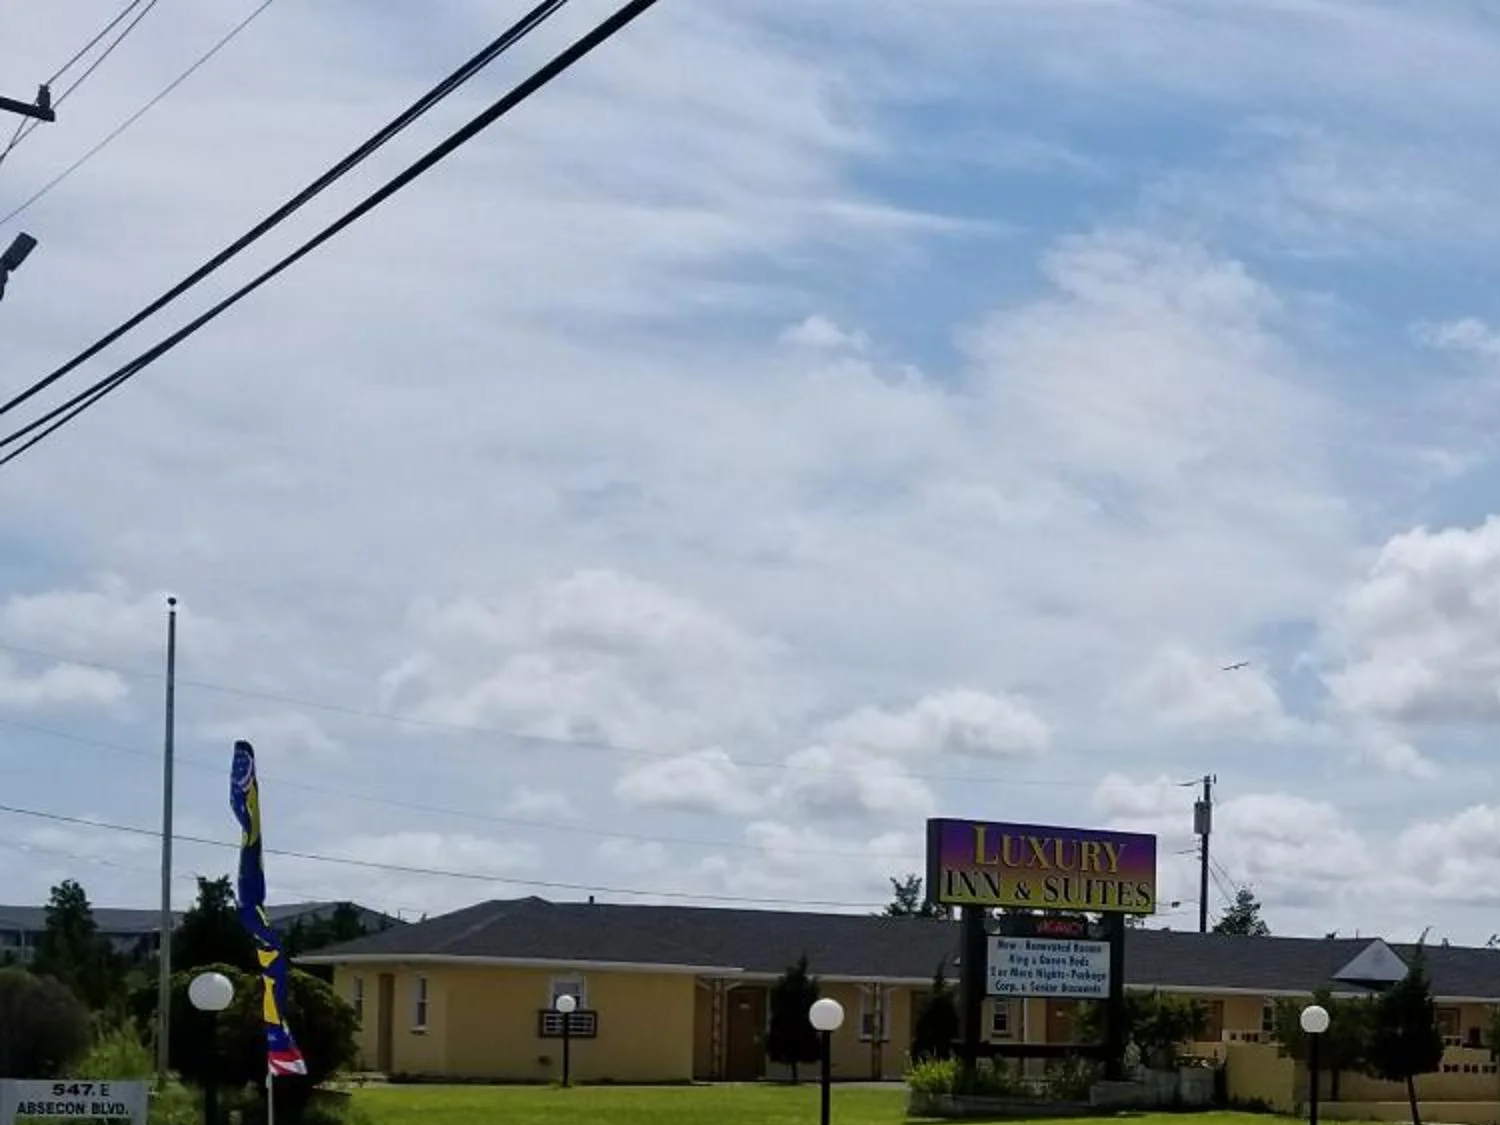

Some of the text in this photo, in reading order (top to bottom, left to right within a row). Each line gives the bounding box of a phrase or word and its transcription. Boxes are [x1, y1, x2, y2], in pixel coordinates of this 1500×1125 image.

[974, 825, 1127, 873] LUXURY
[945, 868, 1152, 907] INN & SUITES
[101, 1083, 110, 1097] E
[16, 1101, 129, 1115] ABSECON BLVD.
